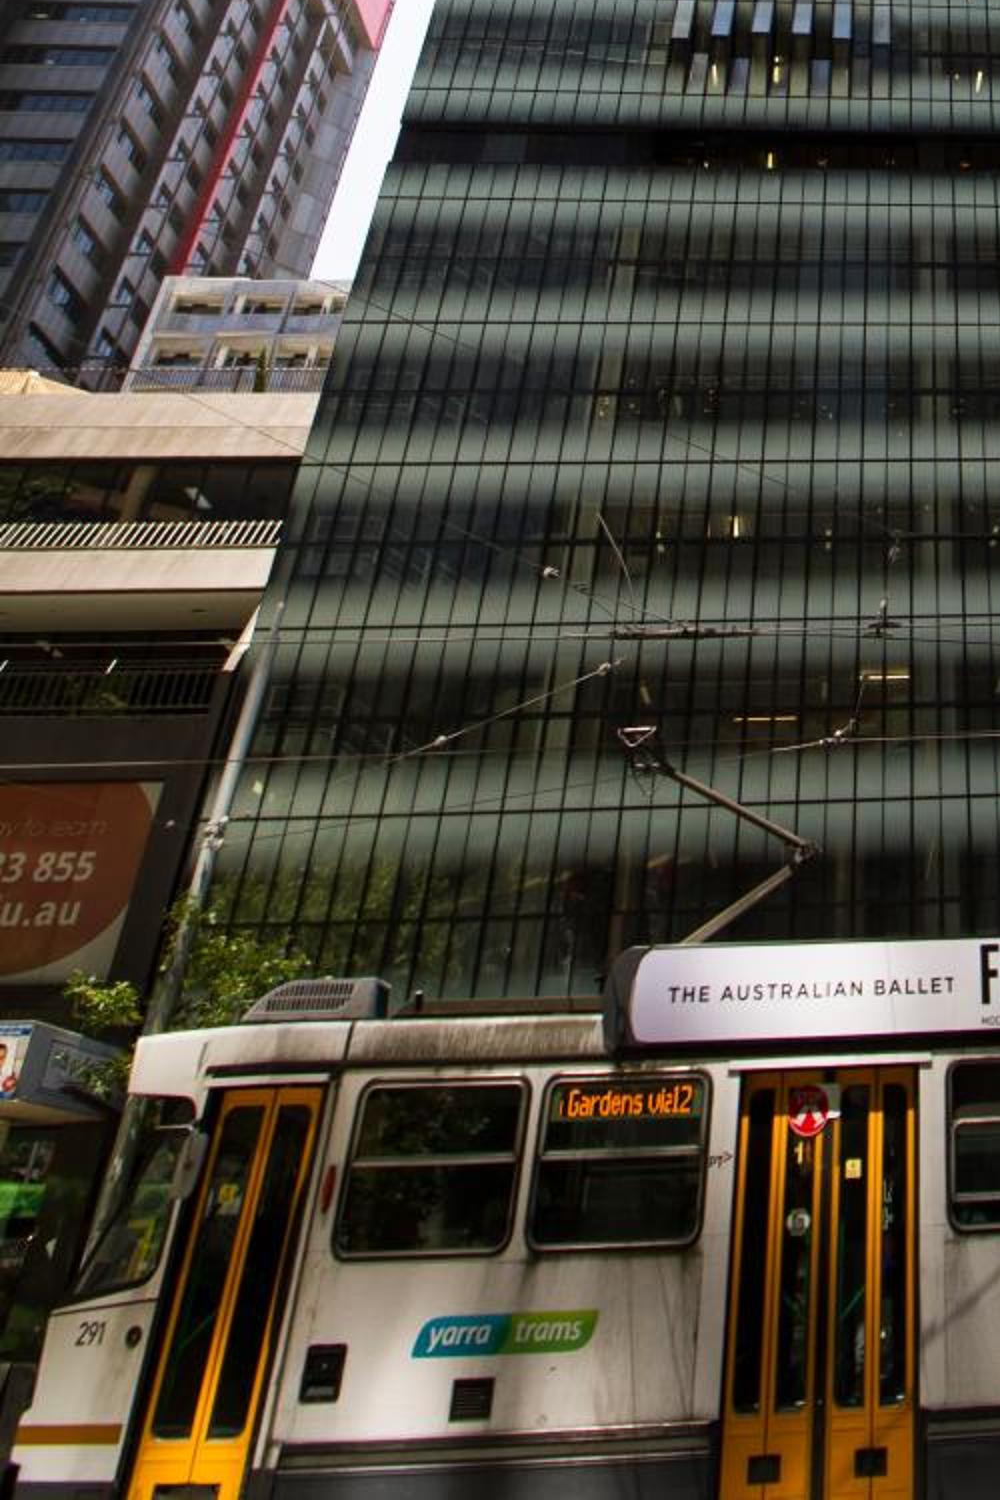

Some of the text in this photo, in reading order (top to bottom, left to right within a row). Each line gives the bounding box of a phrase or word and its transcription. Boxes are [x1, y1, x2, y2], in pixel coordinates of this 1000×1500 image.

[32, 851, 97, 883] 855
[668, 976, 955, 1003] THE AUSTRALIAN BALLET
[567, 1089, 644, 1118] Gardens
[74, 1321, 107, 1347] 291
[427, 1320, 583, 1353] yarra trams
